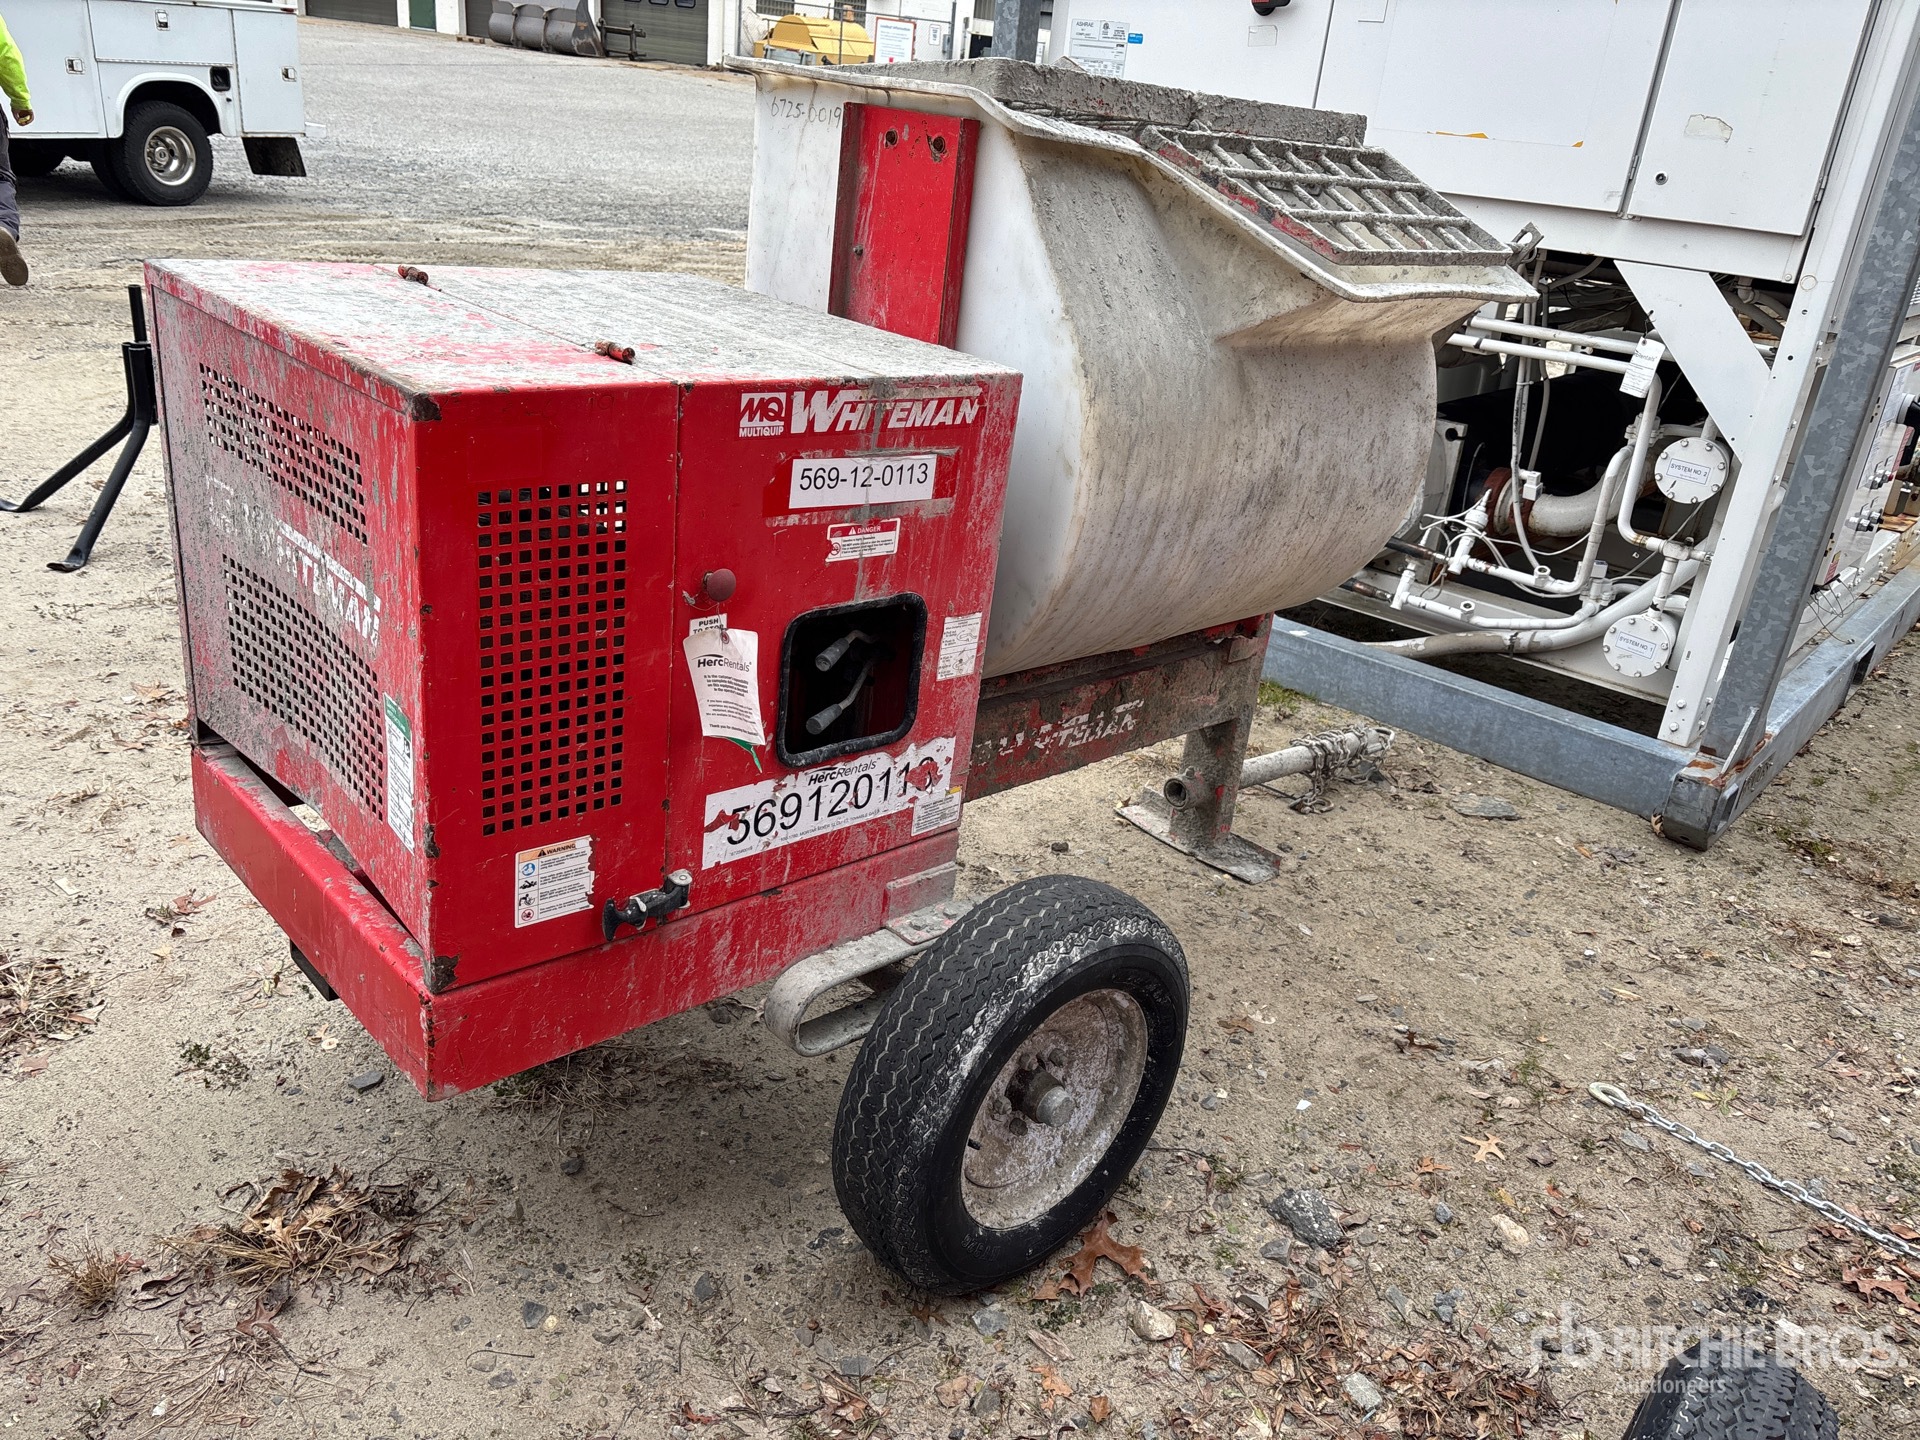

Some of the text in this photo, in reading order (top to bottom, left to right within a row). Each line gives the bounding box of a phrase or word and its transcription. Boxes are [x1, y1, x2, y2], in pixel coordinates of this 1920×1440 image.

[739, 426, 785, 437] MULTIQUIP
[1670, 463, 1693, 473] SYSTEM
[799, 462, 929, 491] 569-12-0113
[857, 525, 882, 534] DANGER
[698, 617, 719, 627] PUSH
[1619, 635, 1640, 647] SYSTEM
[546, 843, 576, 855] WARNING
